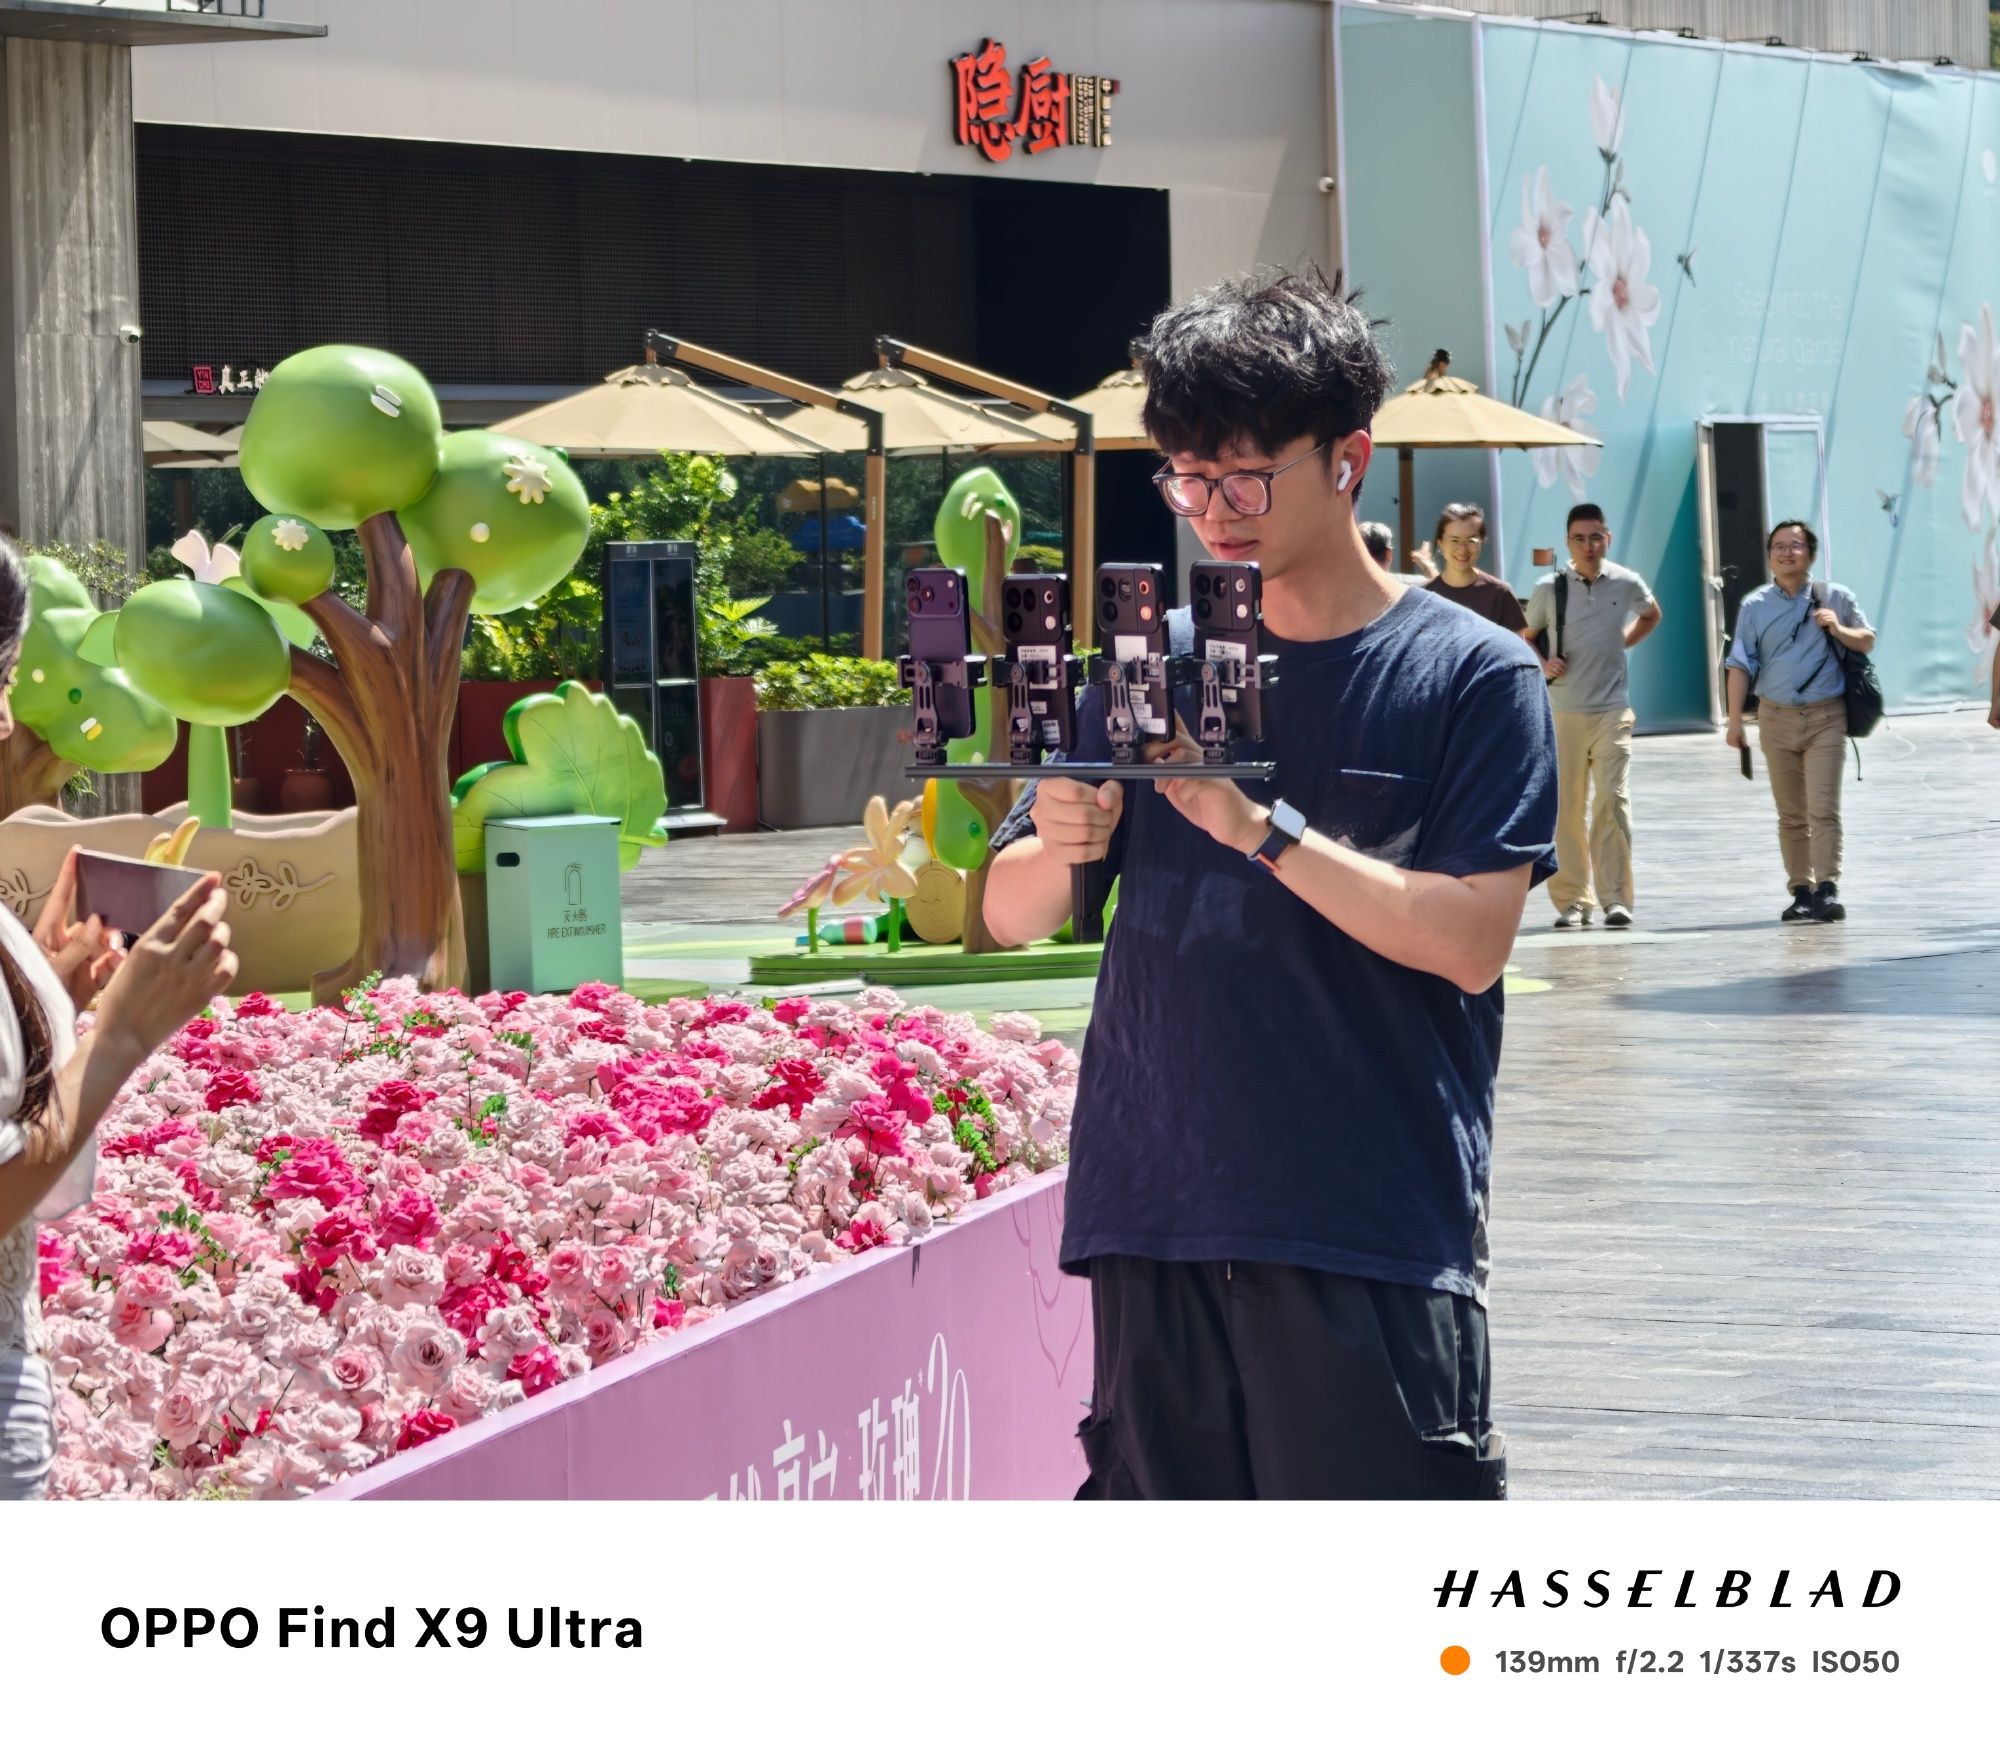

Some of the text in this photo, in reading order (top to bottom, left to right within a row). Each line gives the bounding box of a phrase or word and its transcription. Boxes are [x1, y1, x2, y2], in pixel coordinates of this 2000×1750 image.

[951, 38, 1070, 162] 隐厨
[1792, 329, 1854, 373] garde
[563, 908, 588, 922] 灭火器
